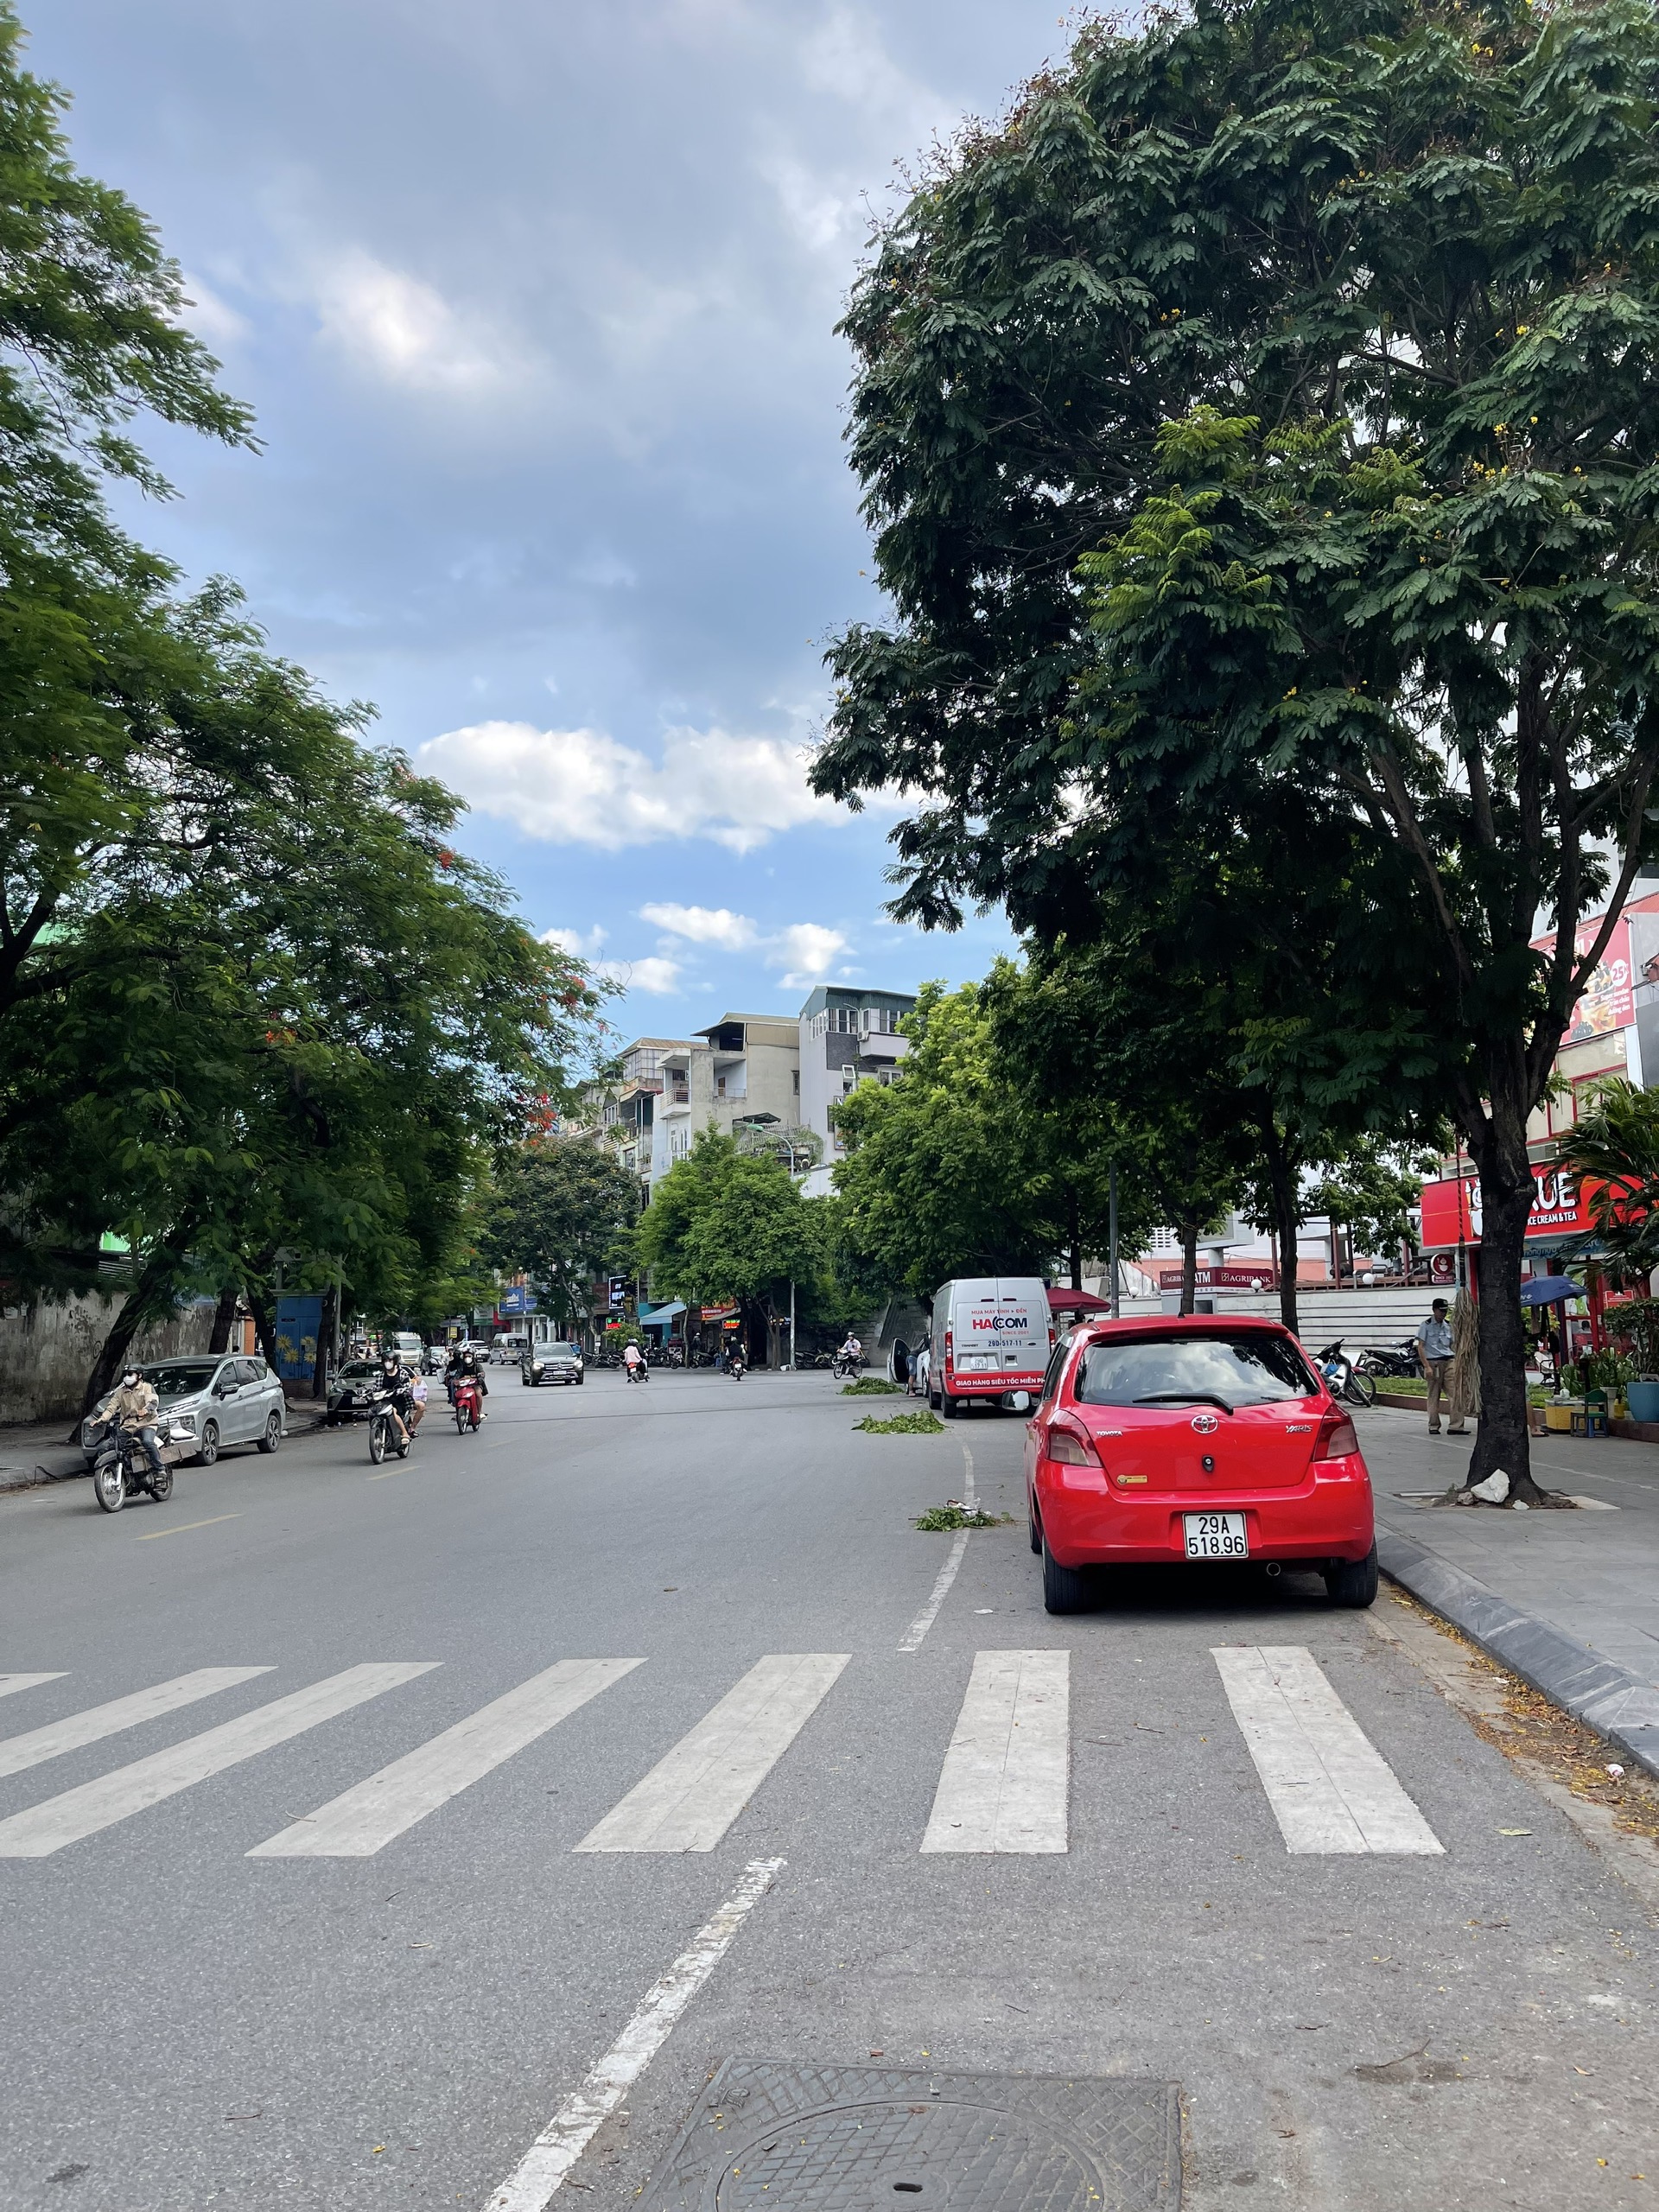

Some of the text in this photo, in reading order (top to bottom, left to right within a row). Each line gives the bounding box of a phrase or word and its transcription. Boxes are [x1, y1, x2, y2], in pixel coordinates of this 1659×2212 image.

[1527, 1211, 1577, 1225] ICE CREAM & TEA
[1194, 1271, 1211, 1284] ATM
[1020, 1376, 1036, 1384] MIỄN
[1285, 1424, 1313, 1433] YARIS
[1198, 1516, 1230, 1535] 29A
[1188, 1535, 1244, 1554] 518.96
